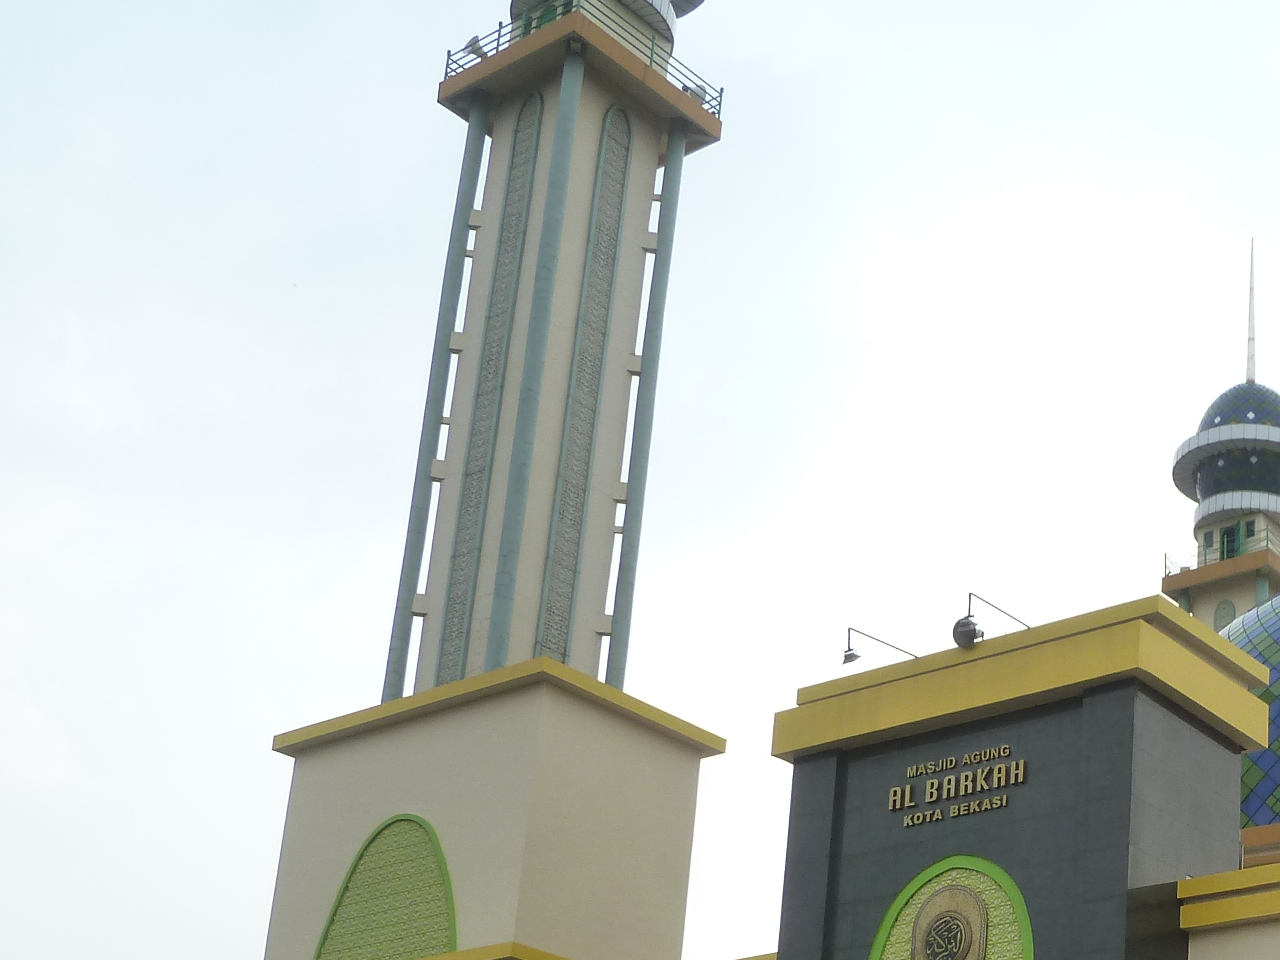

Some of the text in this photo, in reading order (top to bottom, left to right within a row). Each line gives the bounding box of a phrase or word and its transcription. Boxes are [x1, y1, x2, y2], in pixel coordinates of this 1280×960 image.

[907, 744, 1010, 778] MASJID AGUNG
[888, 759, 1025, 811] AL BARKAH
[903, 794, 1008, 827] KOTA BEKASI
